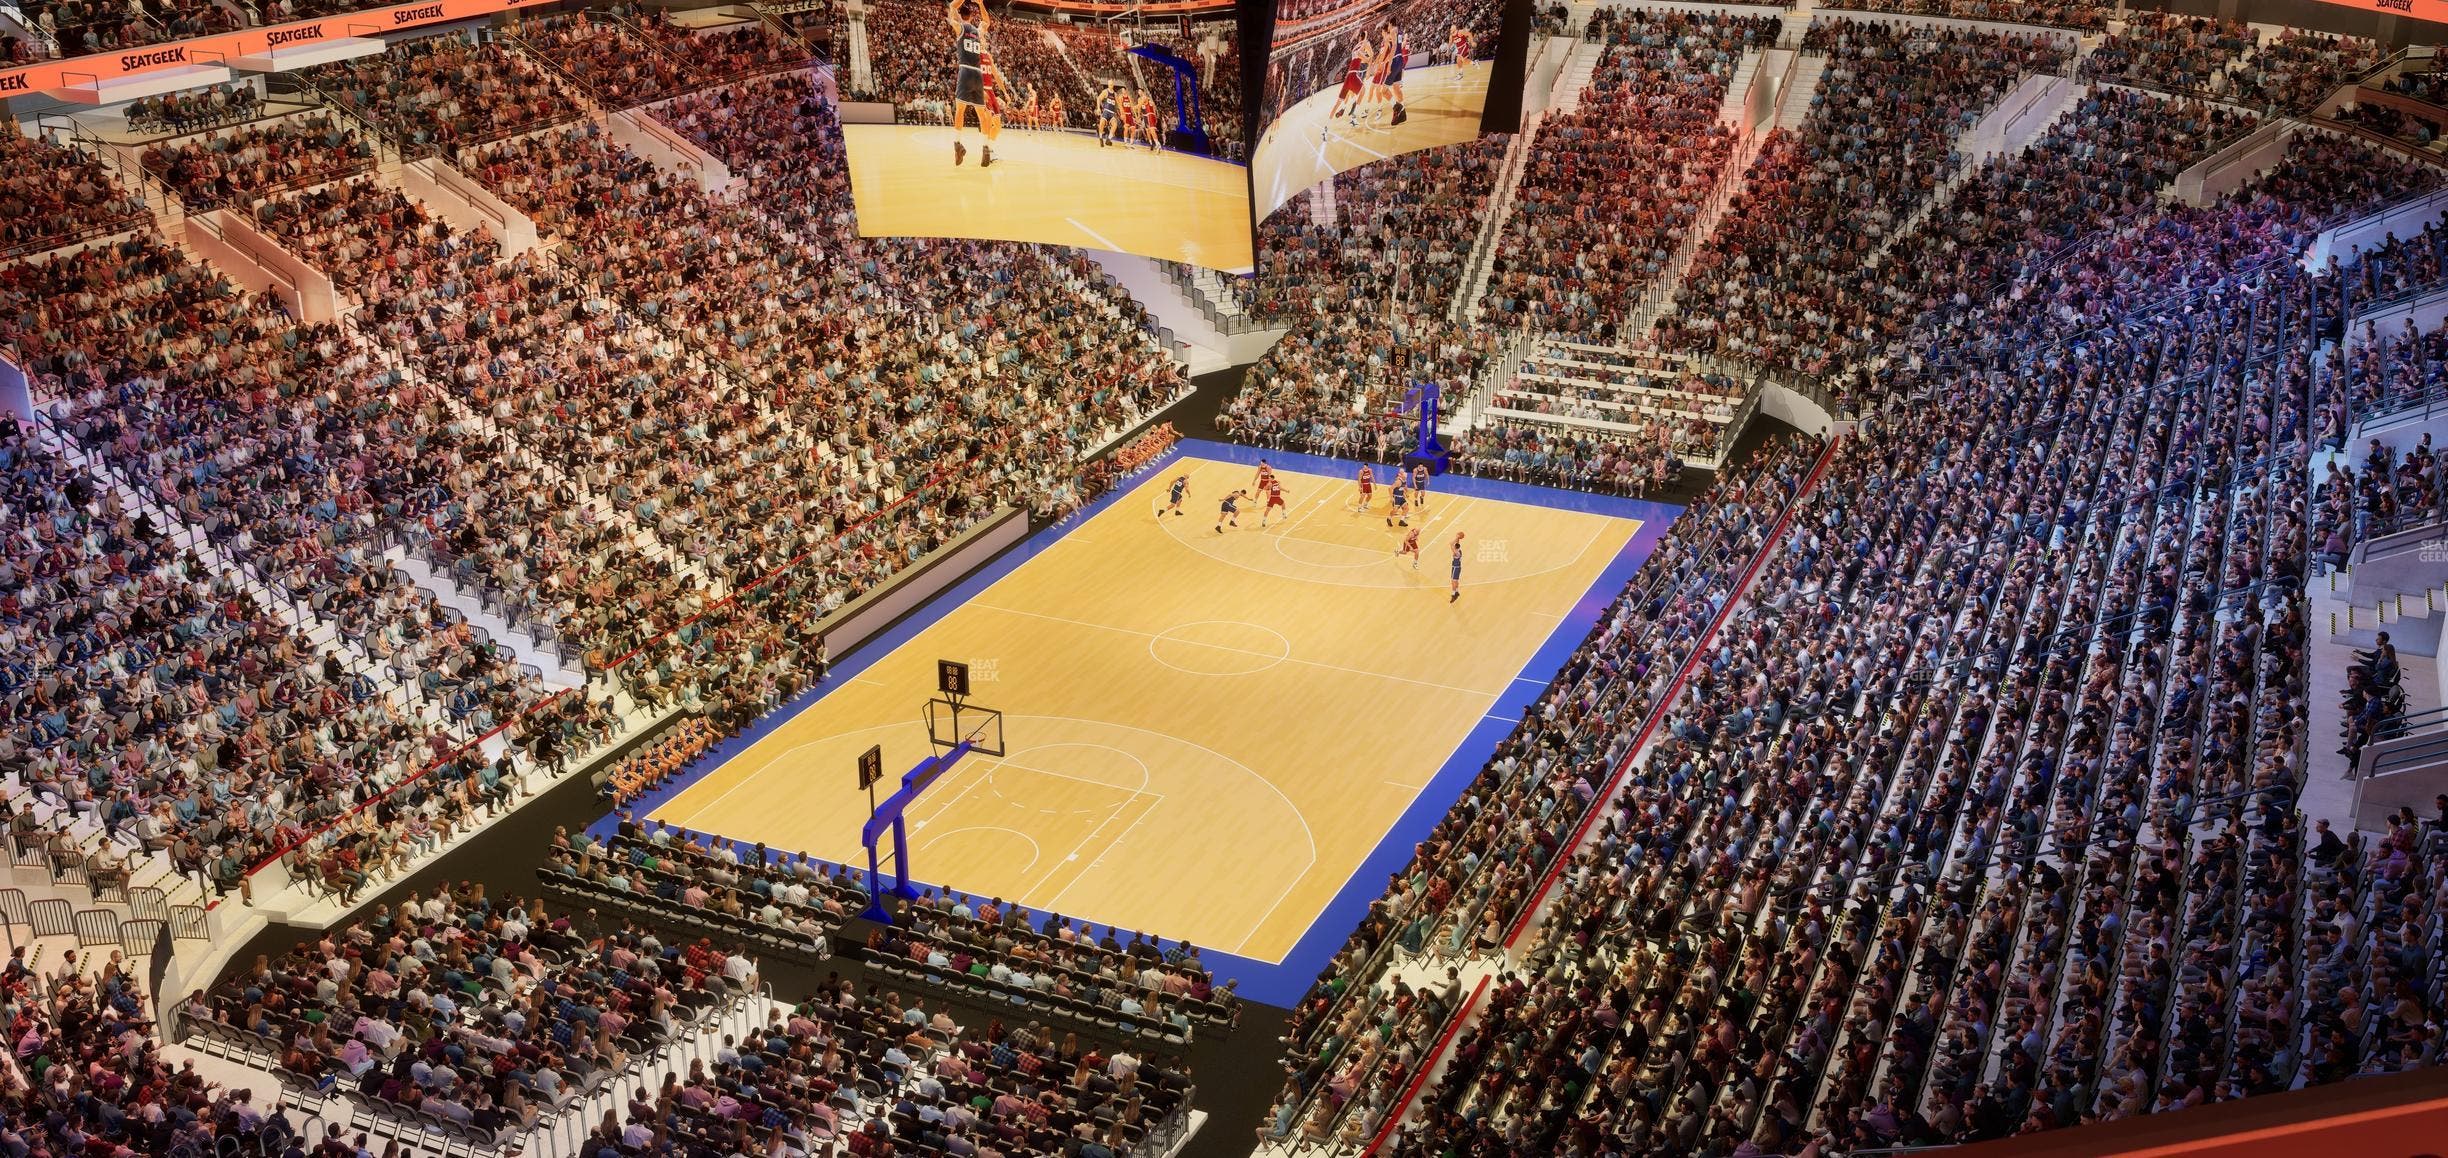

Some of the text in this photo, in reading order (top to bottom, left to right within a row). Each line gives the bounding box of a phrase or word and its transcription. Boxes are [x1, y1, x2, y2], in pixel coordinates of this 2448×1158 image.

[394, 4, 444, 25] SEATGEEK
[266, 24, 324, 47] SEATGEEK
[121, 47, 186, 71] SEATGEEK
